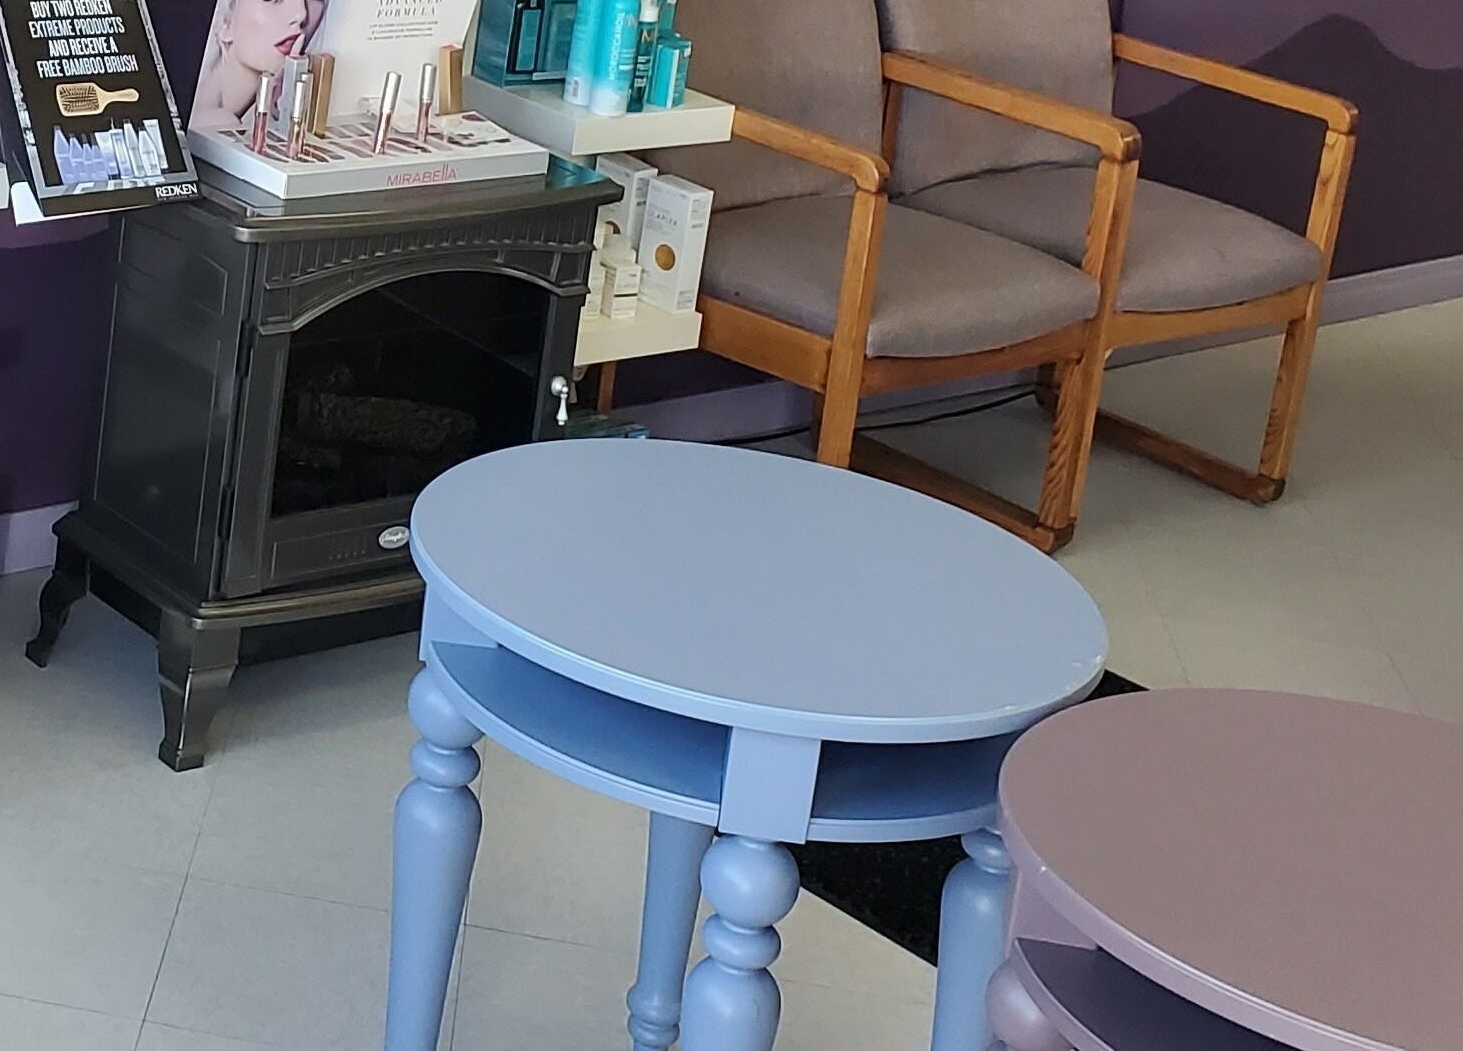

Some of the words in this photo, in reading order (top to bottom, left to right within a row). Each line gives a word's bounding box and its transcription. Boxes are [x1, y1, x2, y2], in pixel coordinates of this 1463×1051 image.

[29, 0, 52, 19] BUY
[50, 0, 75, 18] TWO
[28, 18, 76, 38] EXTREME
[73, 16, 126, 36] PRODUCTS
[48, 38, 70, 58] AND
[68, 36, 111, 56] RECEIVE
[109, 36, 119, 53] A
[36, 59, 64, 79] FREE
[61, 56, 105, 76] BAMBOO
[103, 54, 139, 73] BRUSH
[155, 182, 198, 198] REDKEN
